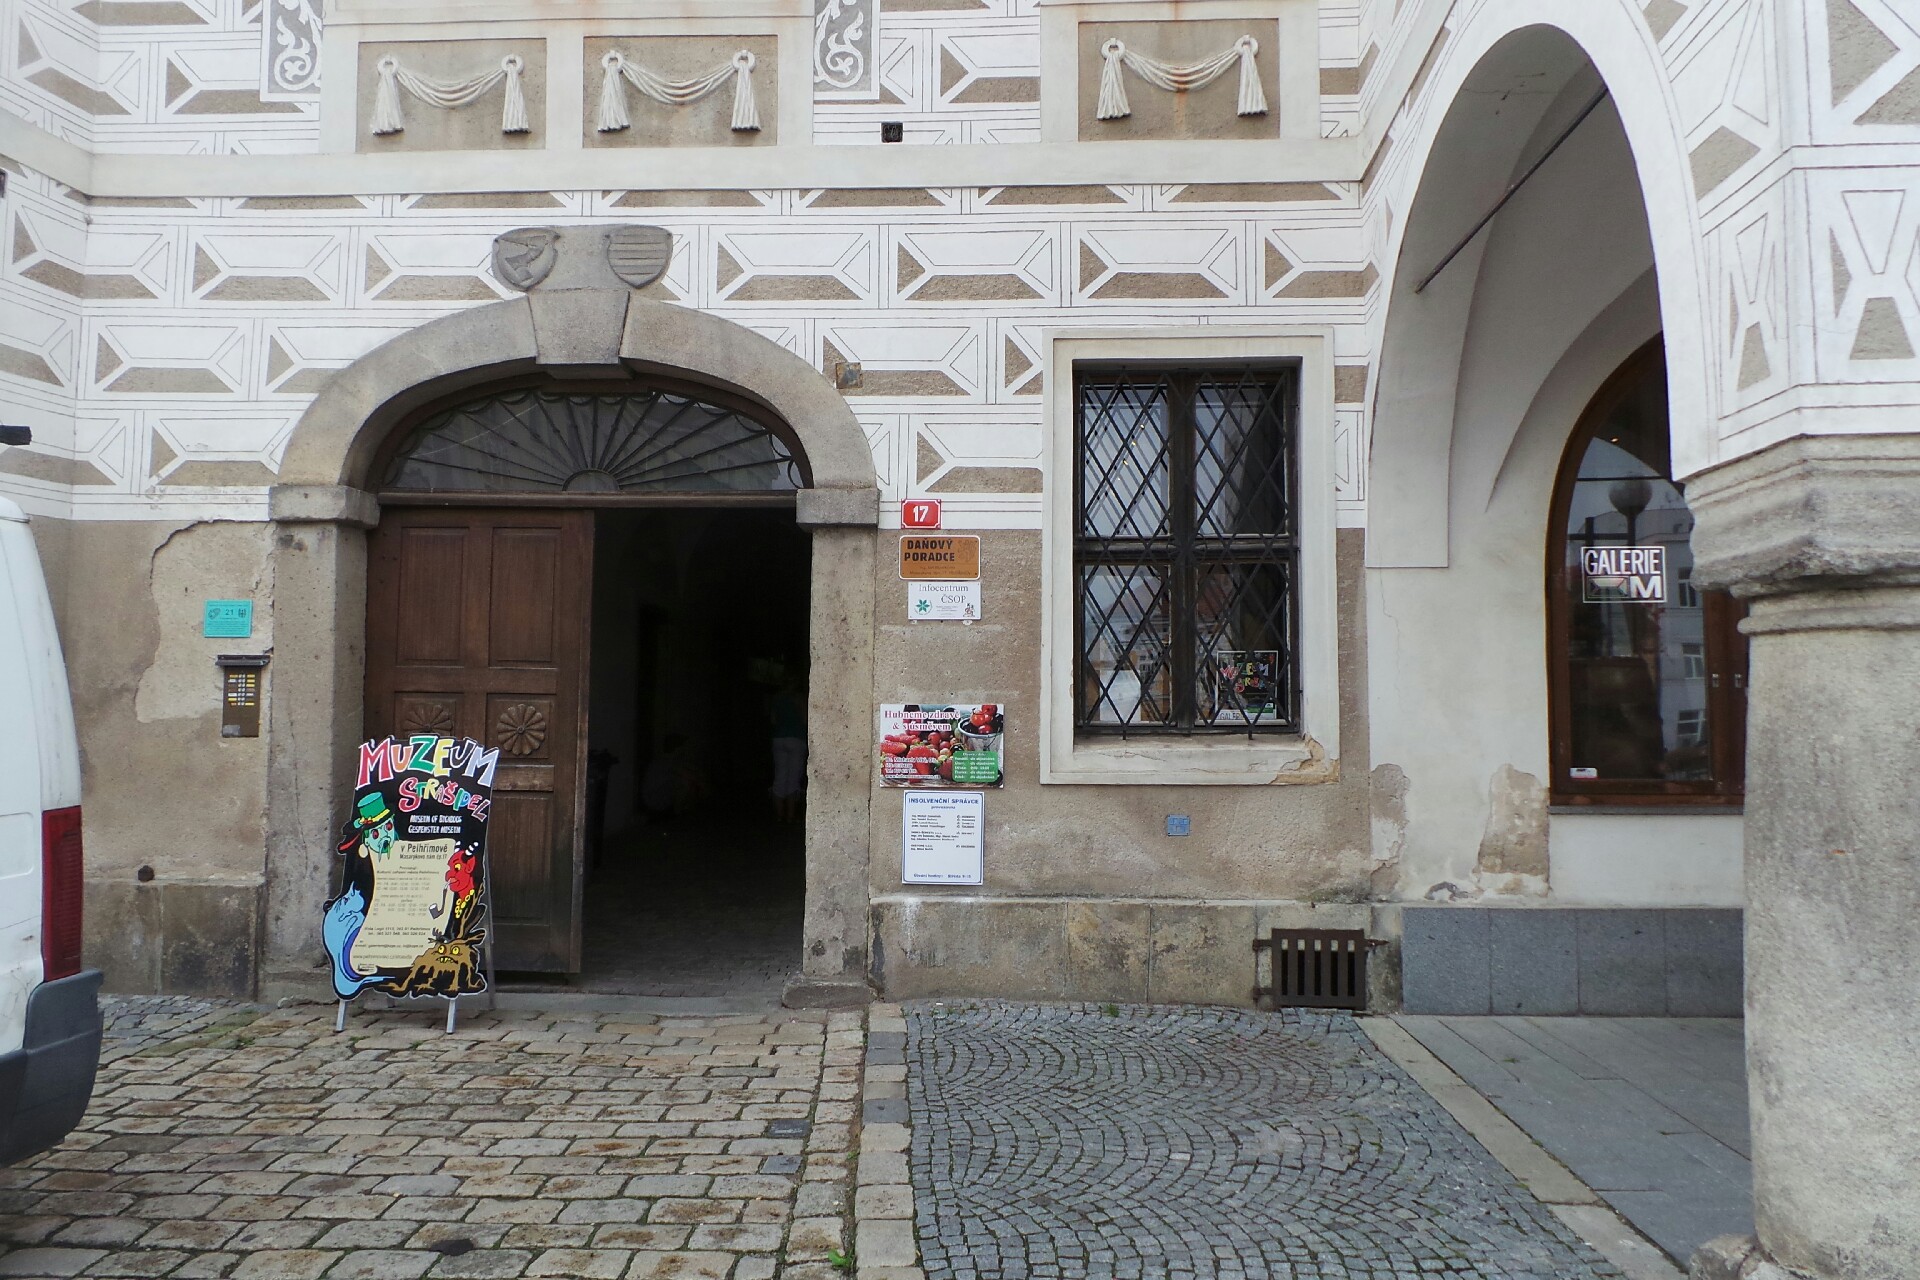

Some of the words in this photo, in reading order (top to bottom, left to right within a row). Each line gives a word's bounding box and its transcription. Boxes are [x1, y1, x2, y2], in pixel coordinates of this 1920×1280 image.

[913, 505, 929, 523] 17
[907, 538, 953, 550] DAŇOVÝ
[904, 552, 955, 562] PORADCE
[1585, 550, 1660, 574] GALERIE
[919, 584, 969, 592] Infocentrum
[1630, 575, 1663, 598] M
[940, 593, 967, 604] ČSOP
[225, 608, 234, 616] 21
[884, 710, 928, 719] Hubneme
[892, 722, 900, 730] &
[356, 736, 499, 789] MUZEUM
[398, 776, 490, 821] STRAŠIDEL
